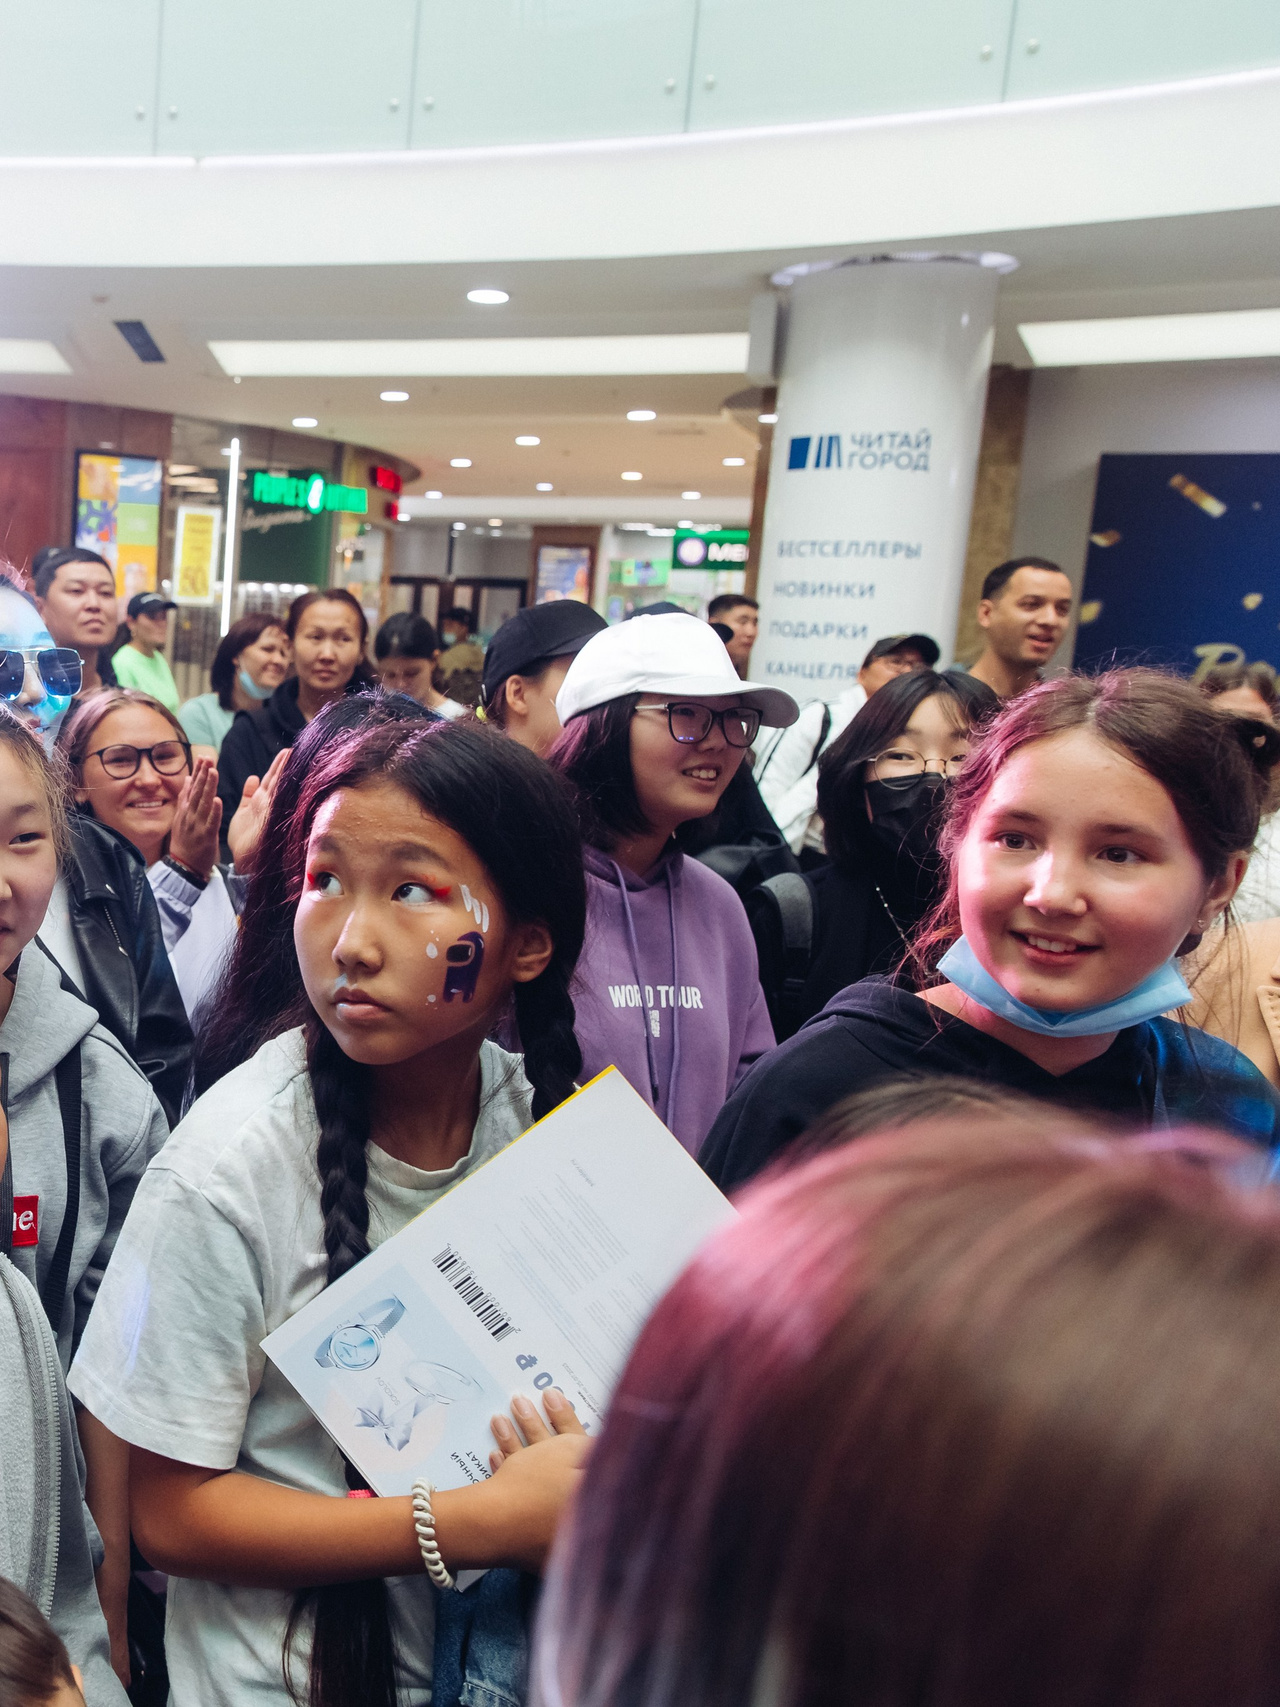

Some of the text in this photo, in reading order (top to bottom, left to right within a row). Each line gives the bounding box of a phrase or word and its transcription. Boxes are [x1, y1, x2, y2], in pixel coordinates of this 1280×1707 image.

[850, 427, 932, 449] ЧИТАЙ
[847, 450, 930, 471] ГОРОД
[777, 540, 922, 558] БЕСТСЕЛЛЕРЫ
[773, 580, 876, 598] НОВИНКИ
[770, 620, 868, 640] ПОДАРКИ
[766, 661, 860, 679] КАНЦЕЛЯ
[607, 984, 654, 1008] WORD
[374, 1375, 400, 1406] SOKOLOV
